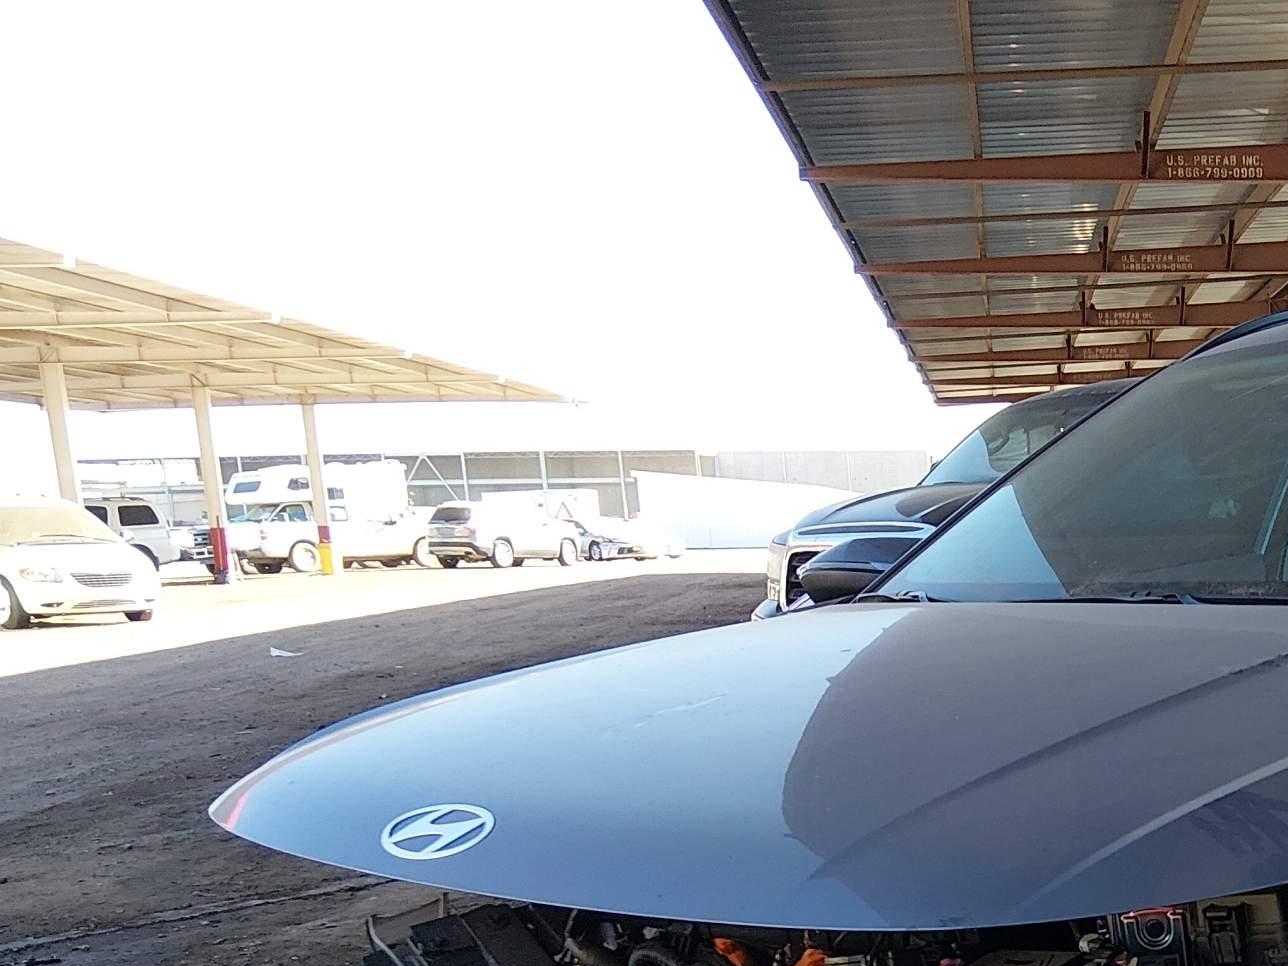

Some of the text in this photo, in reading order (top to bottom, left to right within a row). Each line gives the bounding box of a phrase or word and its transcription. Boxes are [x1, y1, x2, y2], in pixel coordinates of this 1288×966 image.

[1166, 154, 1264, 167] U.S. PREFAB INC.
